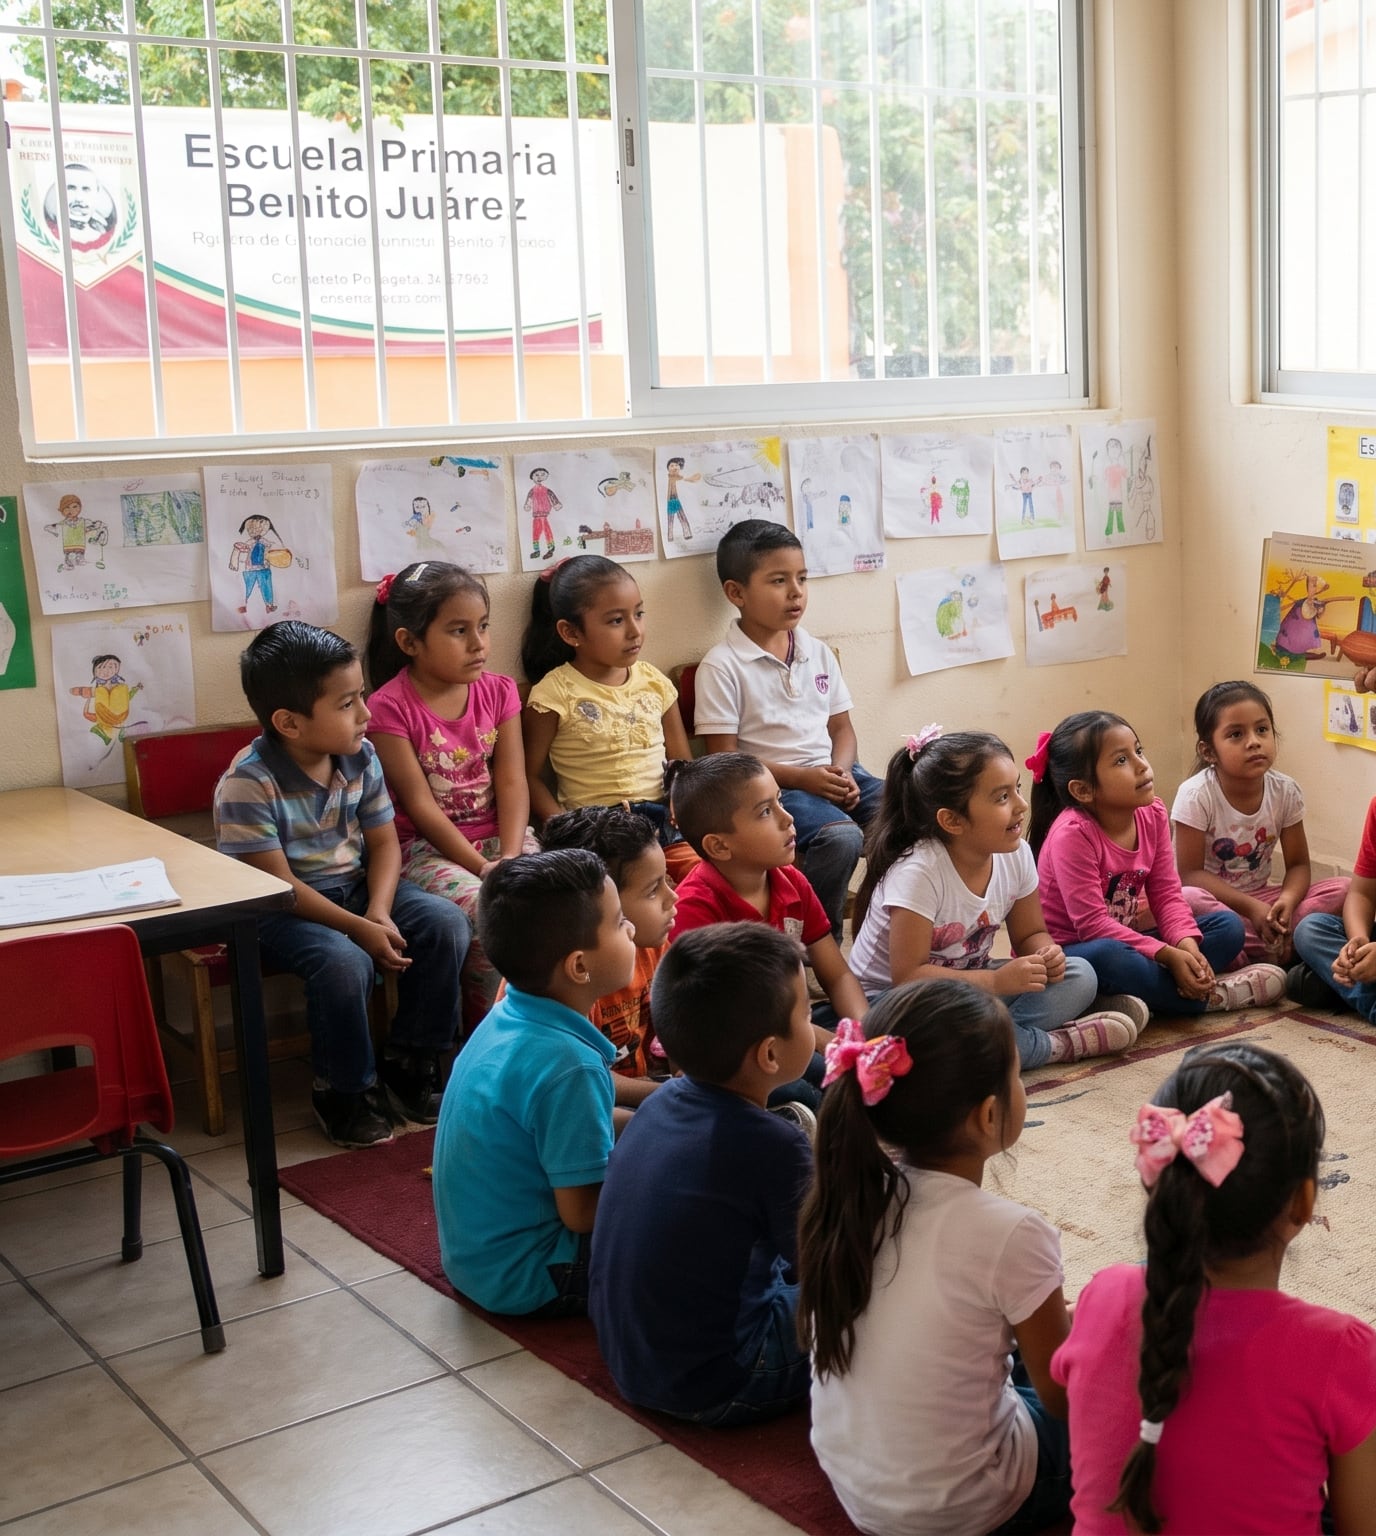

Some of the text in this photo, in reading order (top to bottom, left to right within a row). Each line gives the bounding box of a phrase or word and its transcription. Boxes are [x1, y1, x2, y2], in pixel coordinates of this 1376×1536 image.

[185, 134, 557, 175] Escuela Primaria
[227, 183, 527, 221] Benito Juárez
